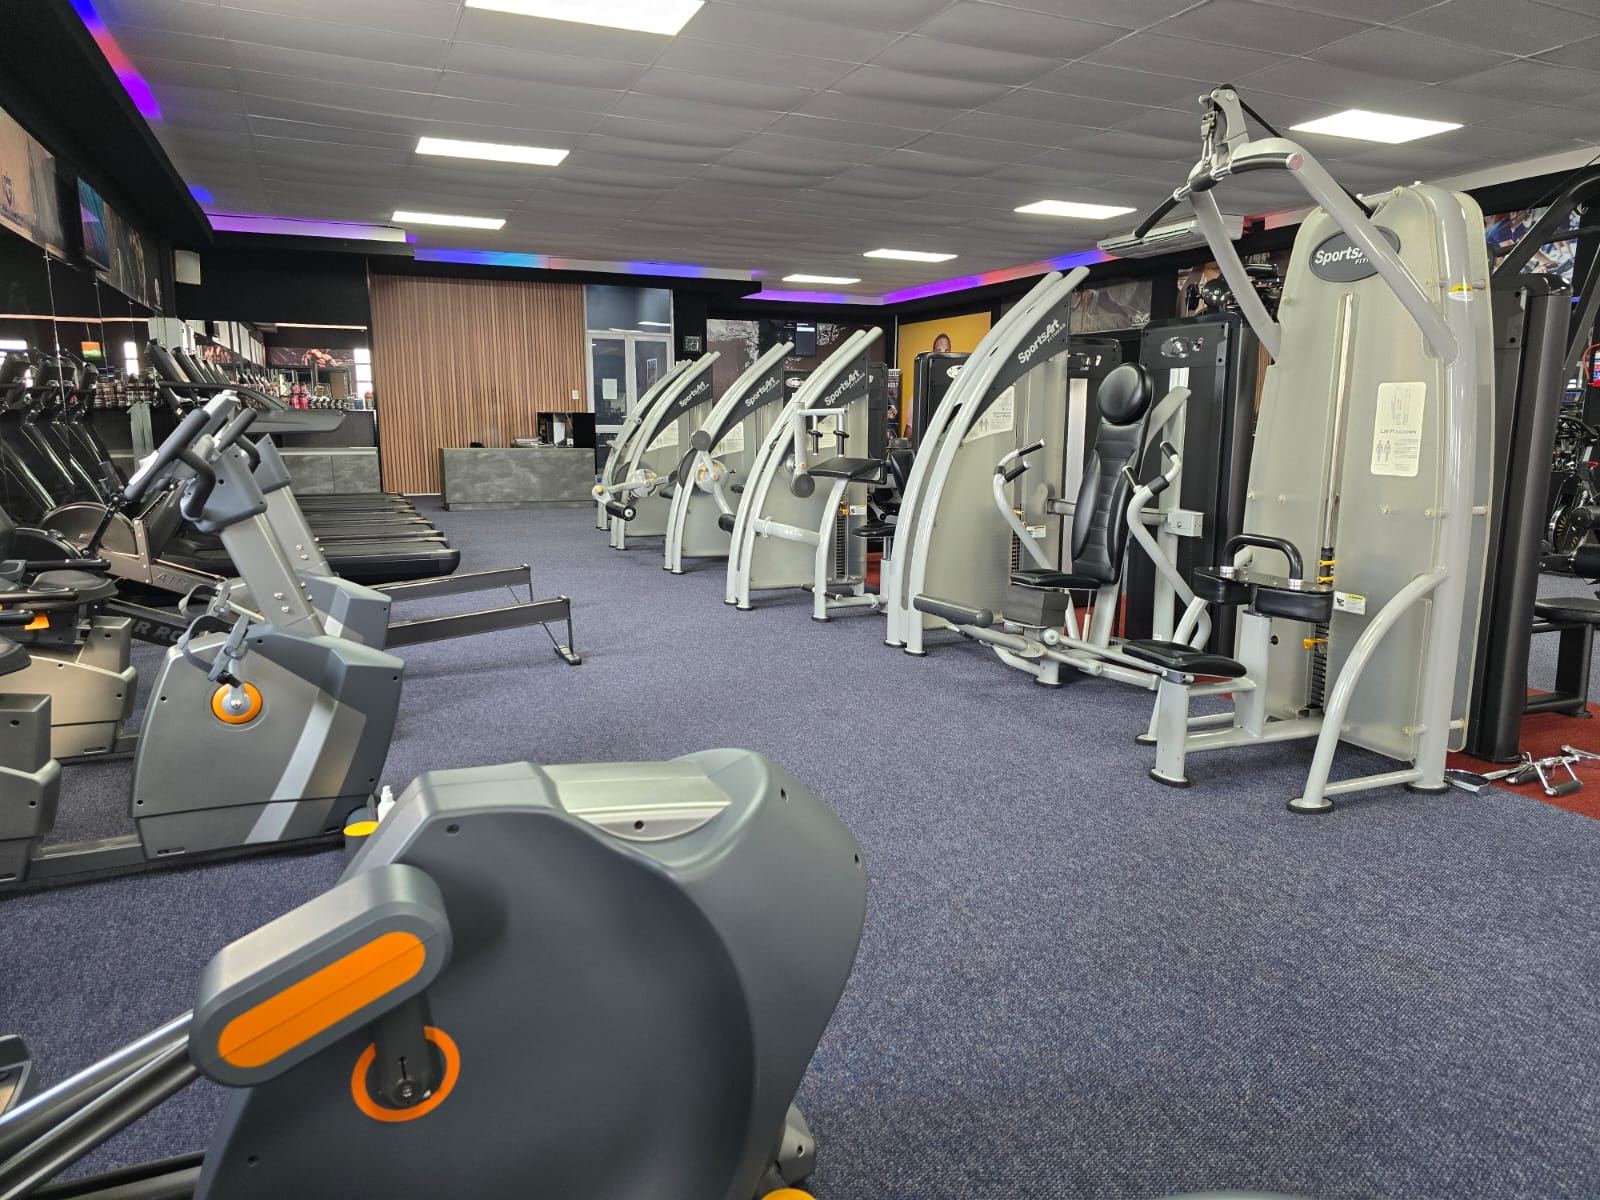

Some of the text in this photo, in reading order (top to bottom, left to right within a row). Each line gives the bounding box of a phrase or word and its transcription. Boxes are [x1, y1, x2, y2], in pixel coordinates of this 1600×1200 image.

[1018, 319, 1060, 364] SportsArt
[745, 376, 776, 408] SportsArt
[824, 369, 860, 406] SportsArt
